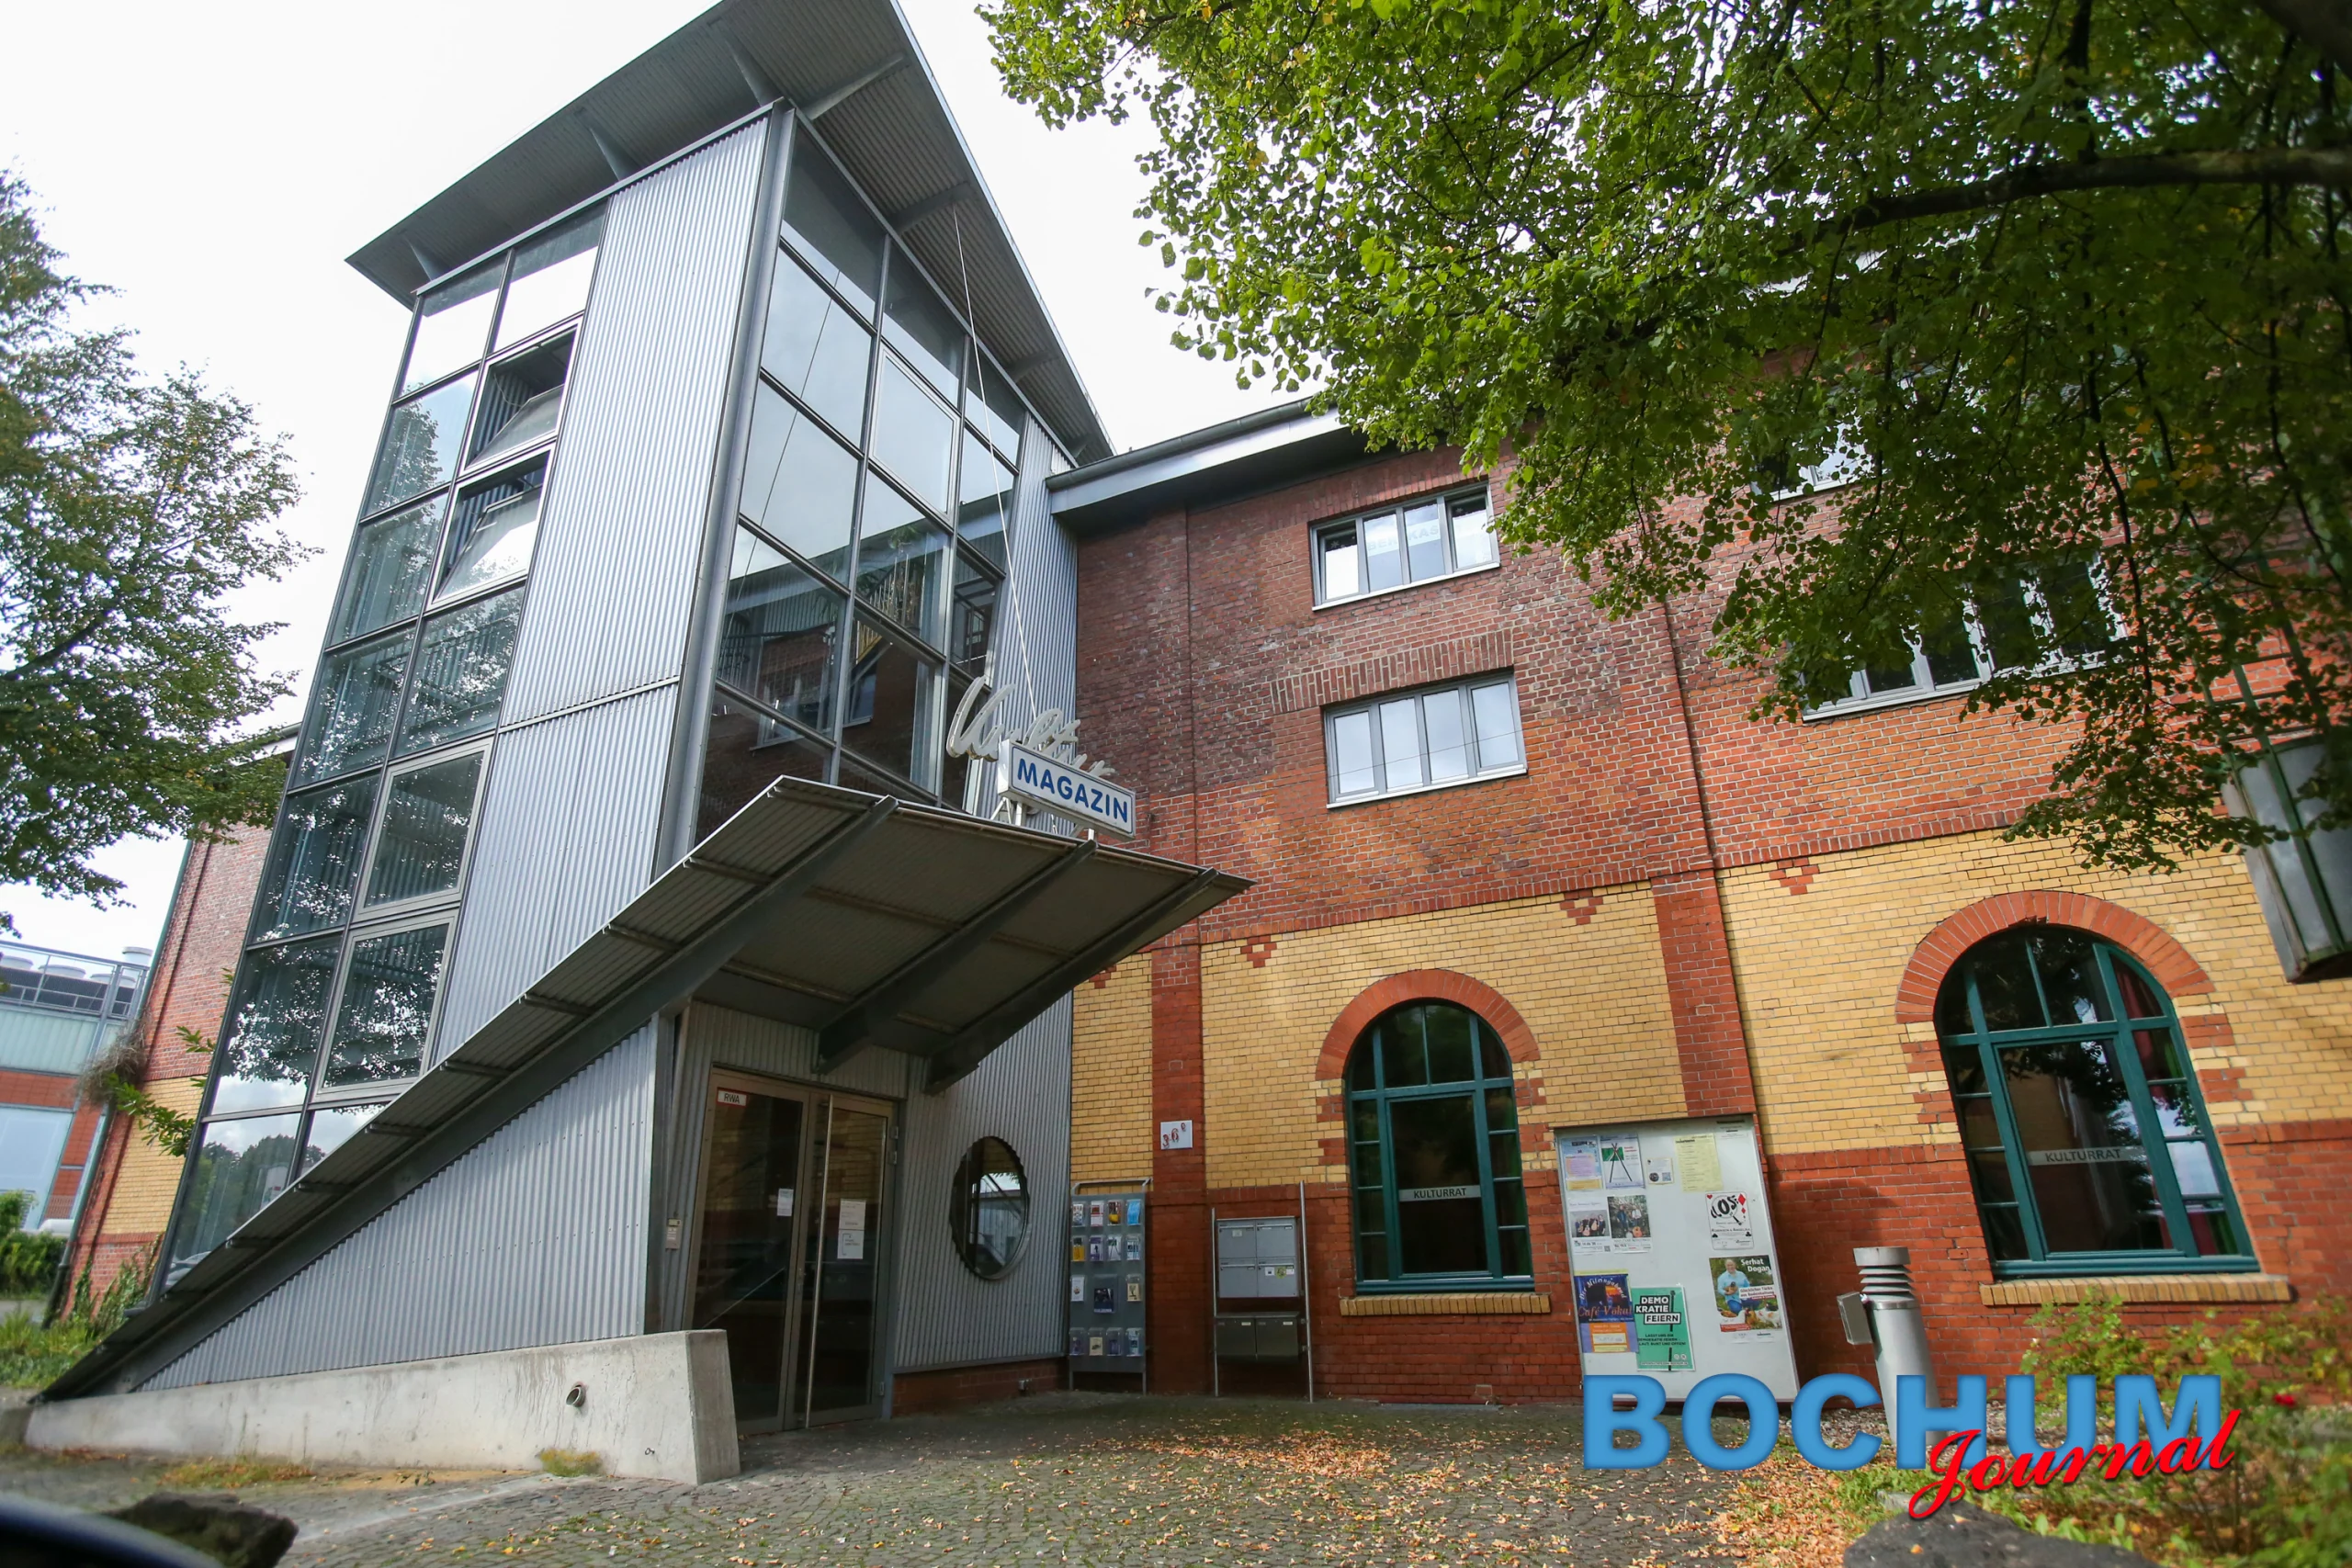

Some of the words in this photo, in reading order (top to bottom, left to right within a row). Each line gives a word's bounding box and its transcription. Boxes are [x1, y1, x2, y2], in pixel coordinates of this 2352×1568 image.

[1017, 758, 1128, 823] MAGAZIN
[723, 1092, 741, 1104] RWA
[2044, 1147, 2121, 1163] KULTURRAT
[1413, 1187, 1467, 1200] KULTURRAT
[1641, 1296, 1669, 1304] DEMO
[1578, 1305, 1600, 1318] Café
[1604, 1304, 1633, 1315] Vokal
